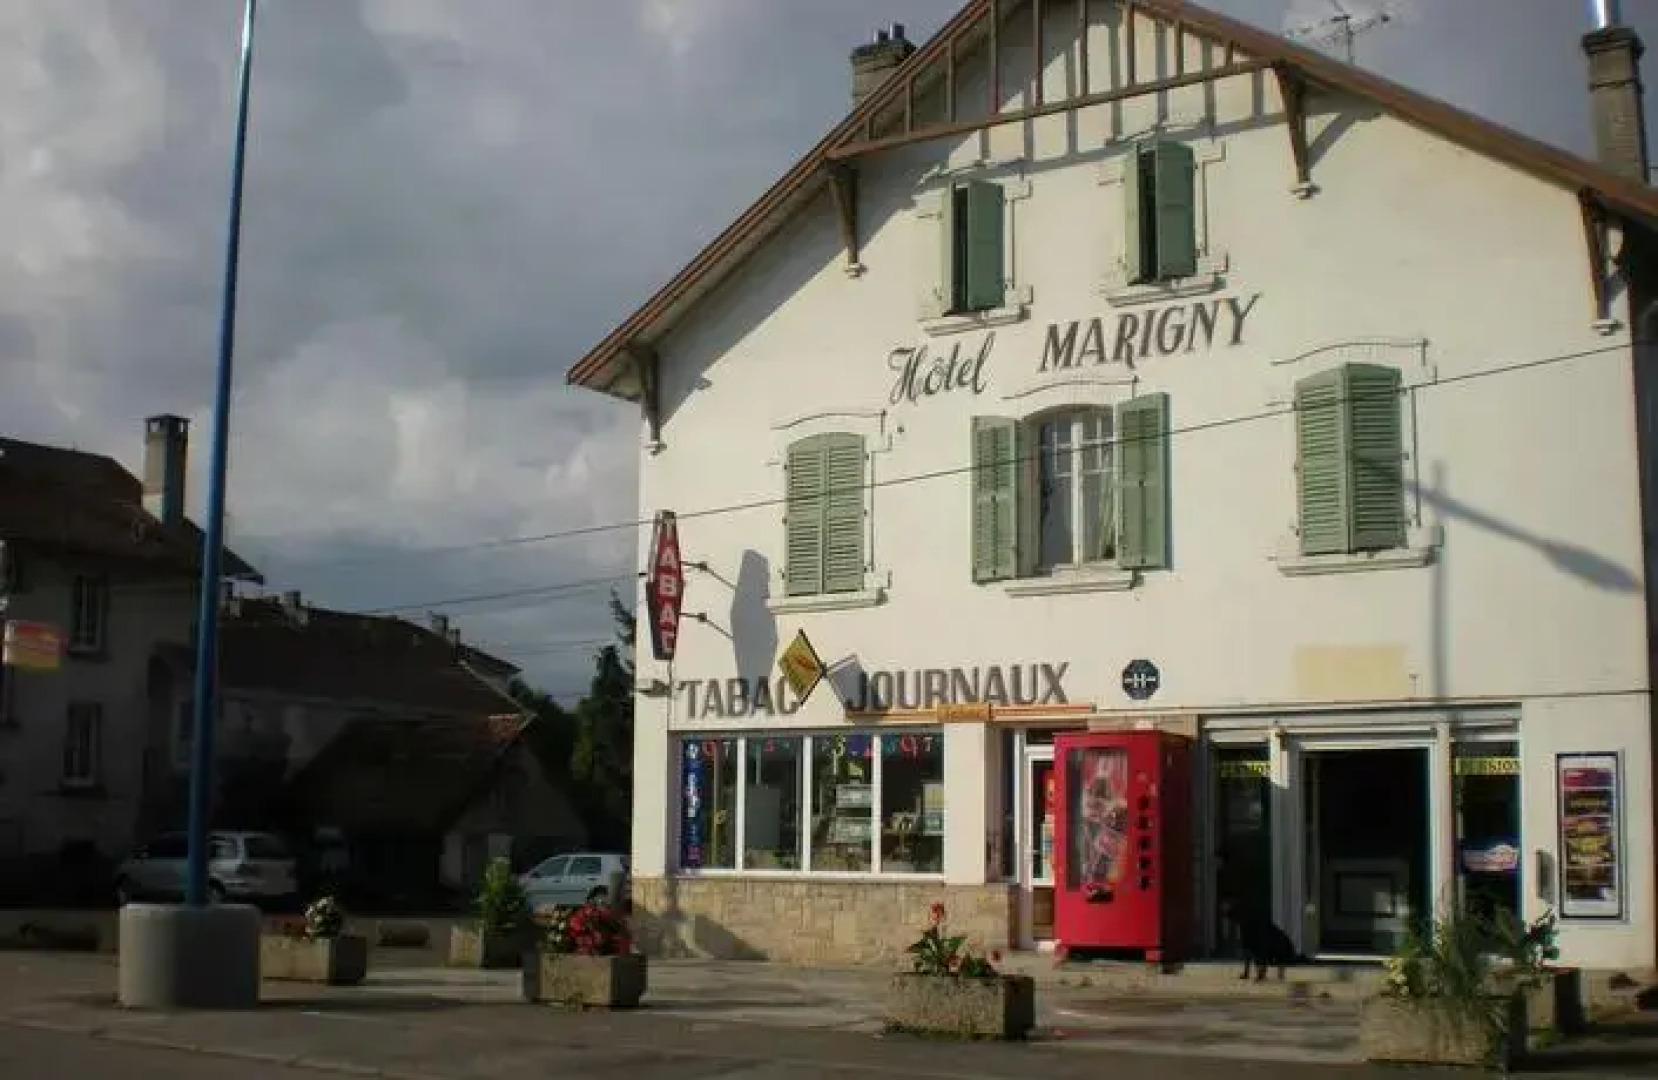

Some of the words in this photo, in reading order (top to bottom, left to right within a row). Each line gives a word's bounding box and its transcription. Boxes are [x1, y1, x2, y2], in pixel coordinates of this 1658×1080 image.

[887, 330, 997, 406] Hôtel
[1036, 291, 1264, 374] MARIGNY
[680, 675, 802, 719] TABAC
[843, 661, 1071, 712] JOURNAUX
